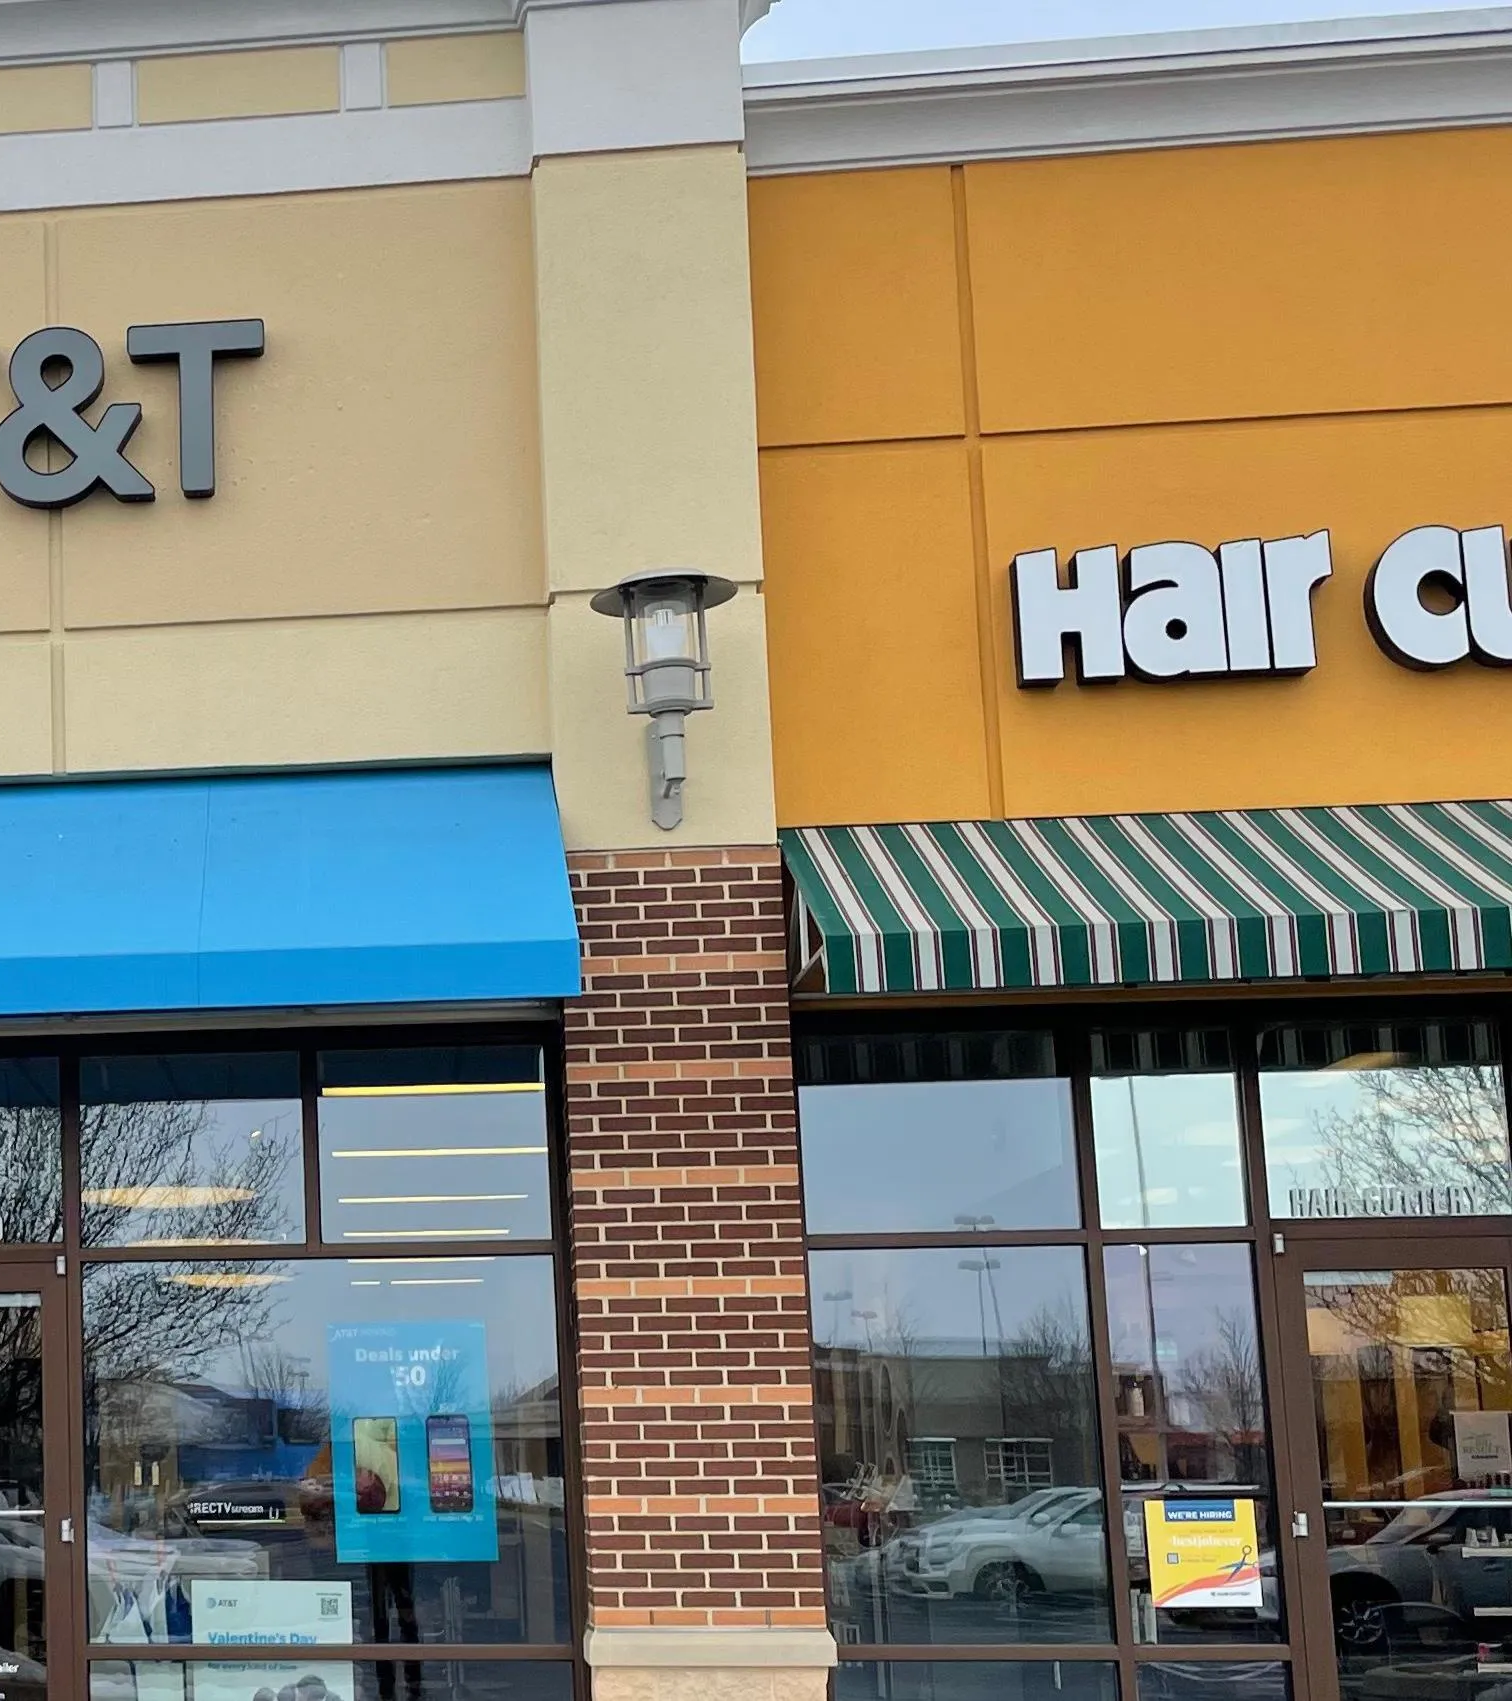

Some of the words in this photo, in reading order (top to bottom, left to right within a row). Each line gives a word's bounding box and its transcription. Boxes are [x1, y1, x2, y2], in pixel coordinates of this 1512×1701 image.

[1011, 529, 1333, 687] Hair
[1289, 1187, 1349, 1216] HAIR
[355, 1347, 403, 1362] Deals
[408, 1345, 459, 1361] under
[390, 1365, 426, 1386] 50
[1168, 1511, 1198, 1520] WE'RE
[1199, 1510, 1232, 1519] HIRING
[218, 1599, 238, 1608] AT&T
[208, 1631, 287, 1645] Valentine's
[290, 1632, 318, 1645] Day
